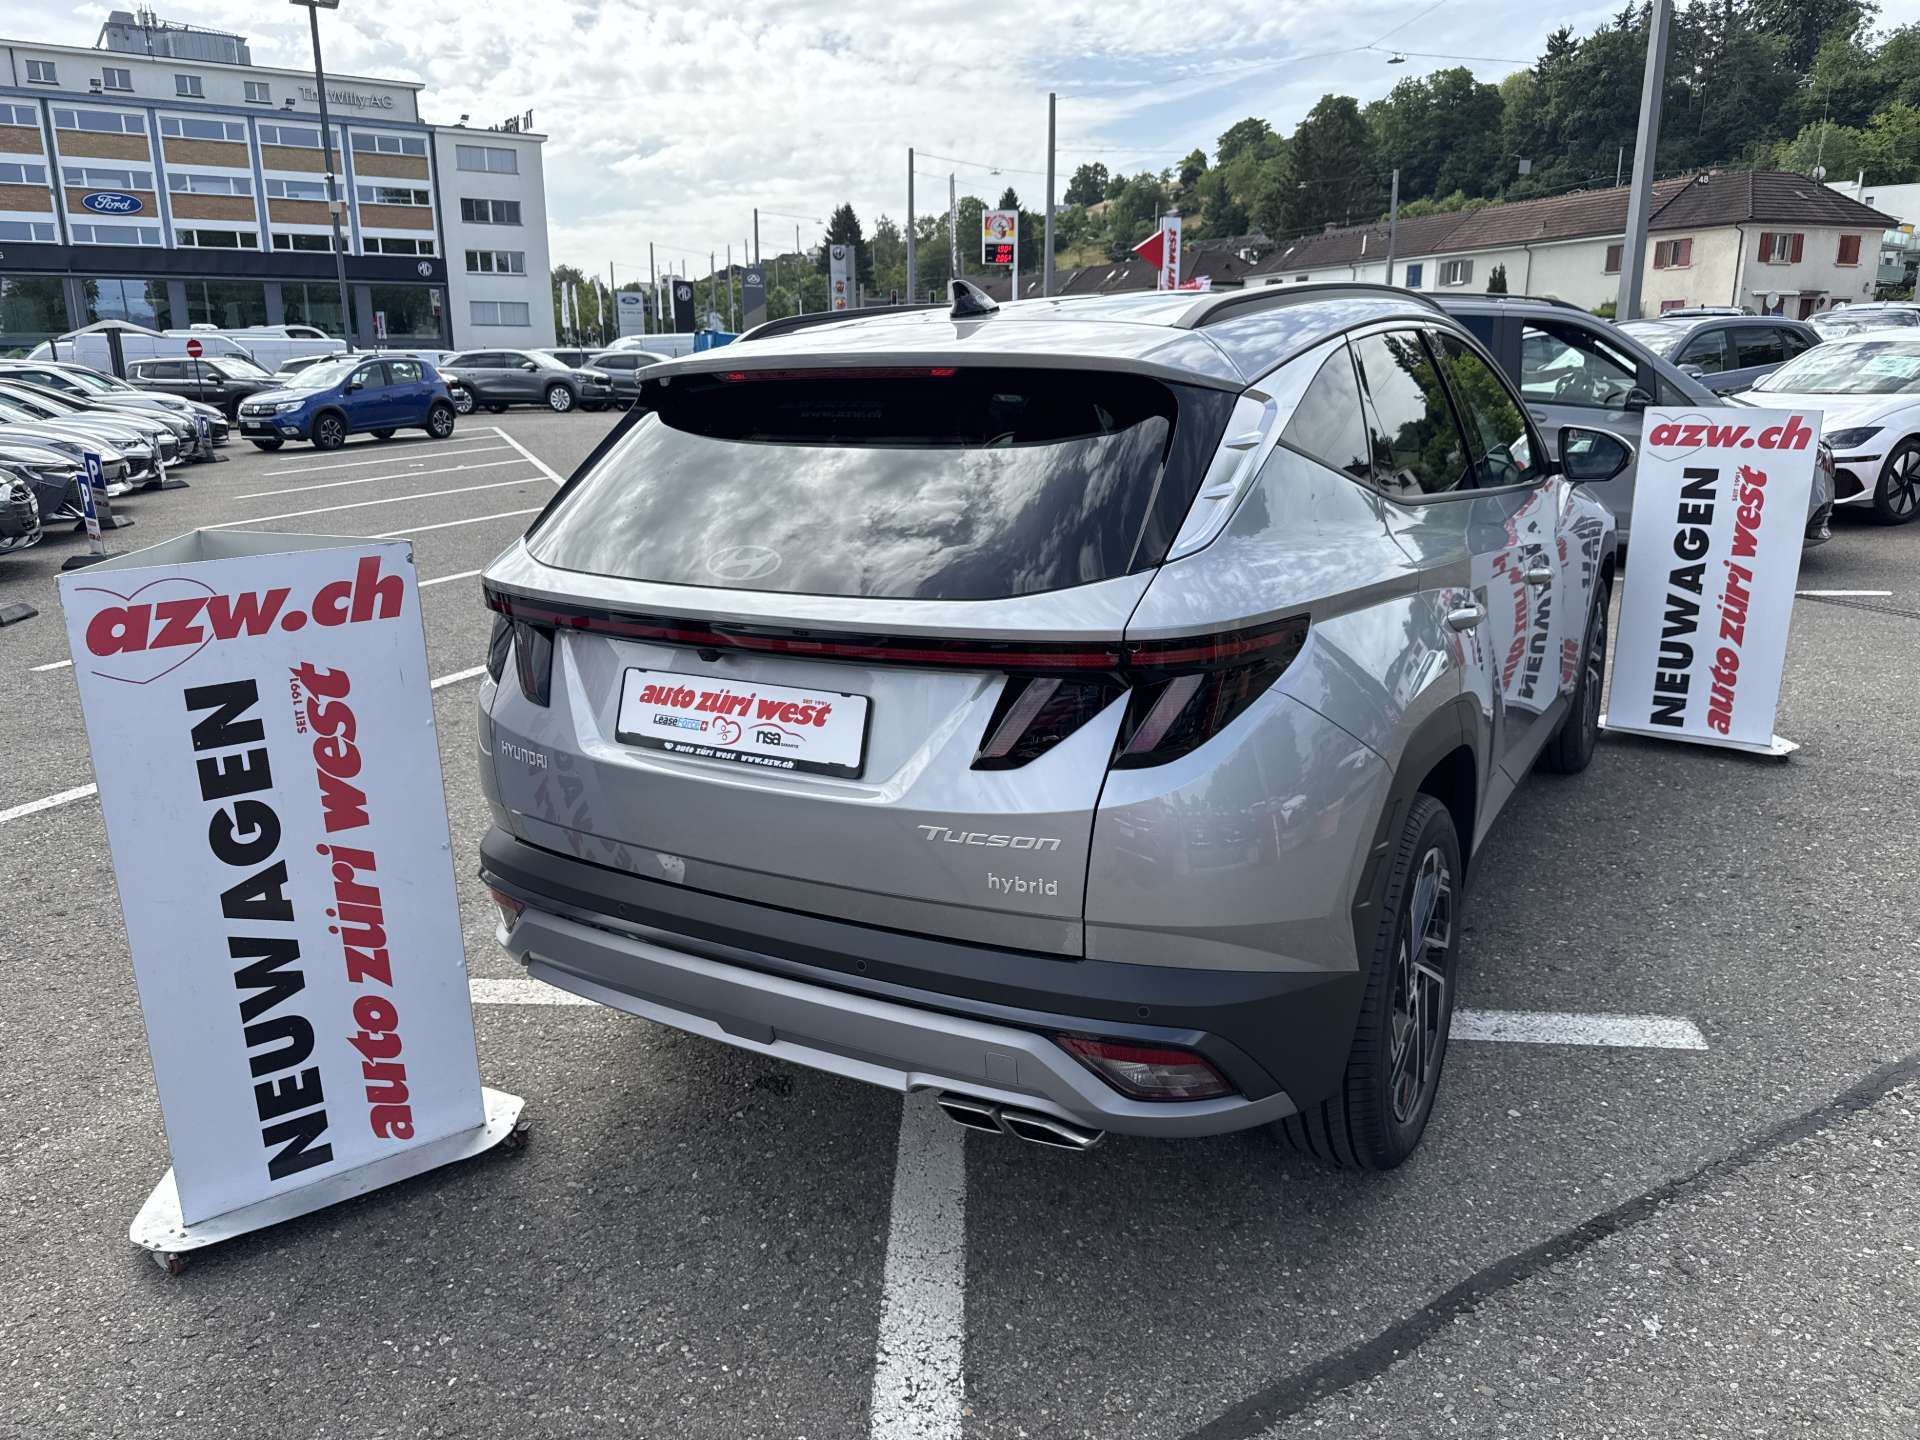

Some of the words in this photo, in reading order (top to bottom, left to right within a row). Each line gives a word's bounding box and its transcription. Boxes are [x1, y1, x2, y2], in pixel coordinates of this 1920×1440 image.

[327, 89, 365, 109] Willy
[370, 95, 393, 109] AG
[1649, 416, 1814, 450] azw.ch
[89, 459, 99, 483] P
[81, 482, 90, 512] P
[1731, 464, 1768, 558] west
[85, 555, 405, 657] azw.ch
[1650, 467, 1720, 728] NEUWAGEN
[1716, 559, 1754, 649] züri
[289, 676, 302, 706] 1991
[640, 684, 695, 709] auto
[695, 689, 757, 717] züri
[756, 698, 833, 728] west
[1707, 646, 1741, 736] auto
[294, 709, 307, 734] SEIT
[756, 730, 781, 746] nsa
[288, 661, 370, 834] west
[502, 740, 548, 769] HYUNDAI
[675, 745, 694, 754] auto
[715, 750, 736, 761] west
[741, 754, 795, 769] www.azw.ch
[917, 824, 1062, 851] Tucson
[987, 872, 1058, 896] hybrid
[184, 678, 334, 1182] NEUWAGEN
[316, 842, 393, 988] züri
[345, 995, 415, 1140] auto
